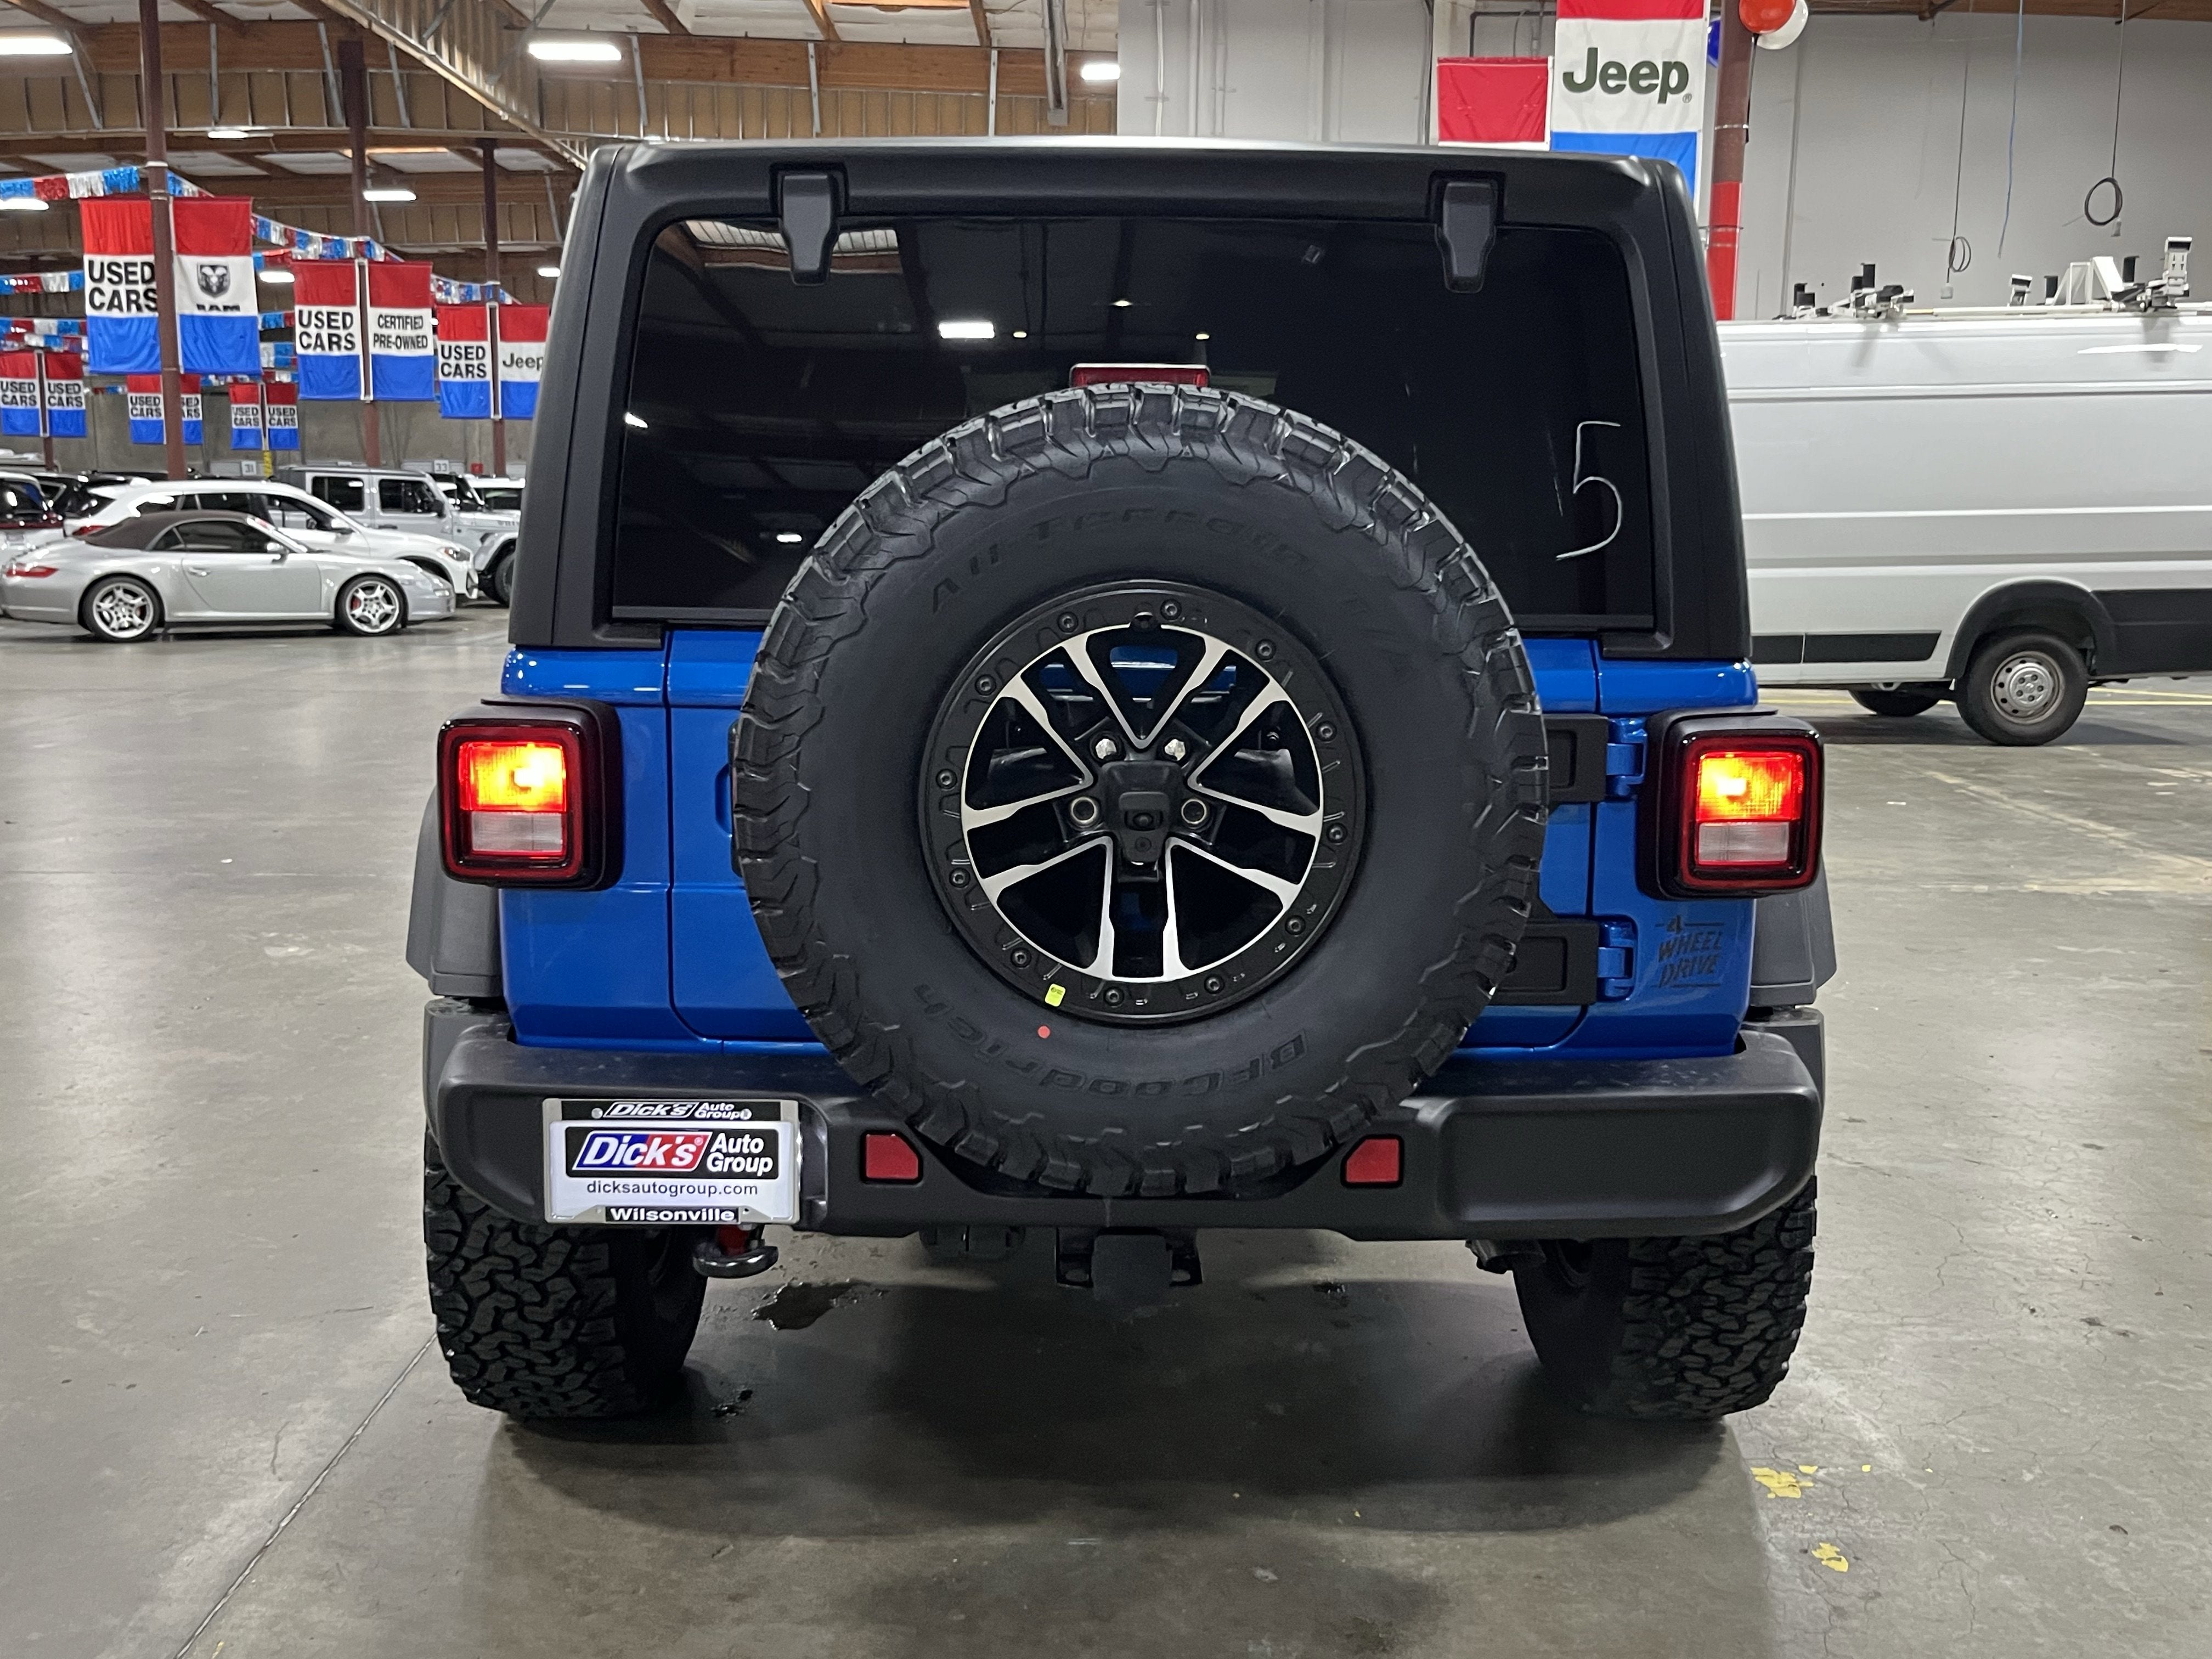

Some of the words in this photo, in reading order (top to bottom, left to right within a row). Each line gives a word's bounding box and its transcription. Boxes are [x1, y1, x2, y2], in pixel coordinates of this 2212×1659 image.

[1563, 47, 1689, 104] Jeep
[88, 259, 155, 285] USED
[89, 287, 158, 313] CARS
[298, 310, 354, 330] USED
[377, 314, 424, 330] CERTIFIED
[299, 331, 356, 351] CARS
[373, 333, 428, 349] PRE-OWNED
[441, 345, 486, 361] USED
[503, 353, 543, 371] Jeep
[441, 363, 487, 379] CARS
[0, 381, 36, 393] USED
[48, 382, 81, 394] USED
[1, 393, 37, 407] CARS
[48, 395, 83, 408] CARS
[130, 396, 161, 407] USED
[180, 397, 200, 407] SED
[131, 407, 162, 417] CARS
[232, 407, 259, 416] USED
[268, 407, 296, 416] USED
[234, 417, 259, 426] CARS
[269, 417, 296, 426] CARS
[1556, 421, 1622, 561] 5
[1666, 915, 1683, 934] 4
[1658, 931, 1722, 962] WHEEL
[1658, 953, 1721, 988] DRIVE
[610, 1103, 689, 1116] Dick's
[695, 1109, 742, 1120] Group
[701, 1103, 734, 1111] Auto
[583, 1136, 692, 1166] Dick's
[710, 1133, 764, 1154] Auto
[707, 1155, 773, 1176] Group
[586, 1180, 758, 1197] dicksautogroup.com
[610, 1208, 735, 1221] Wilsonville
